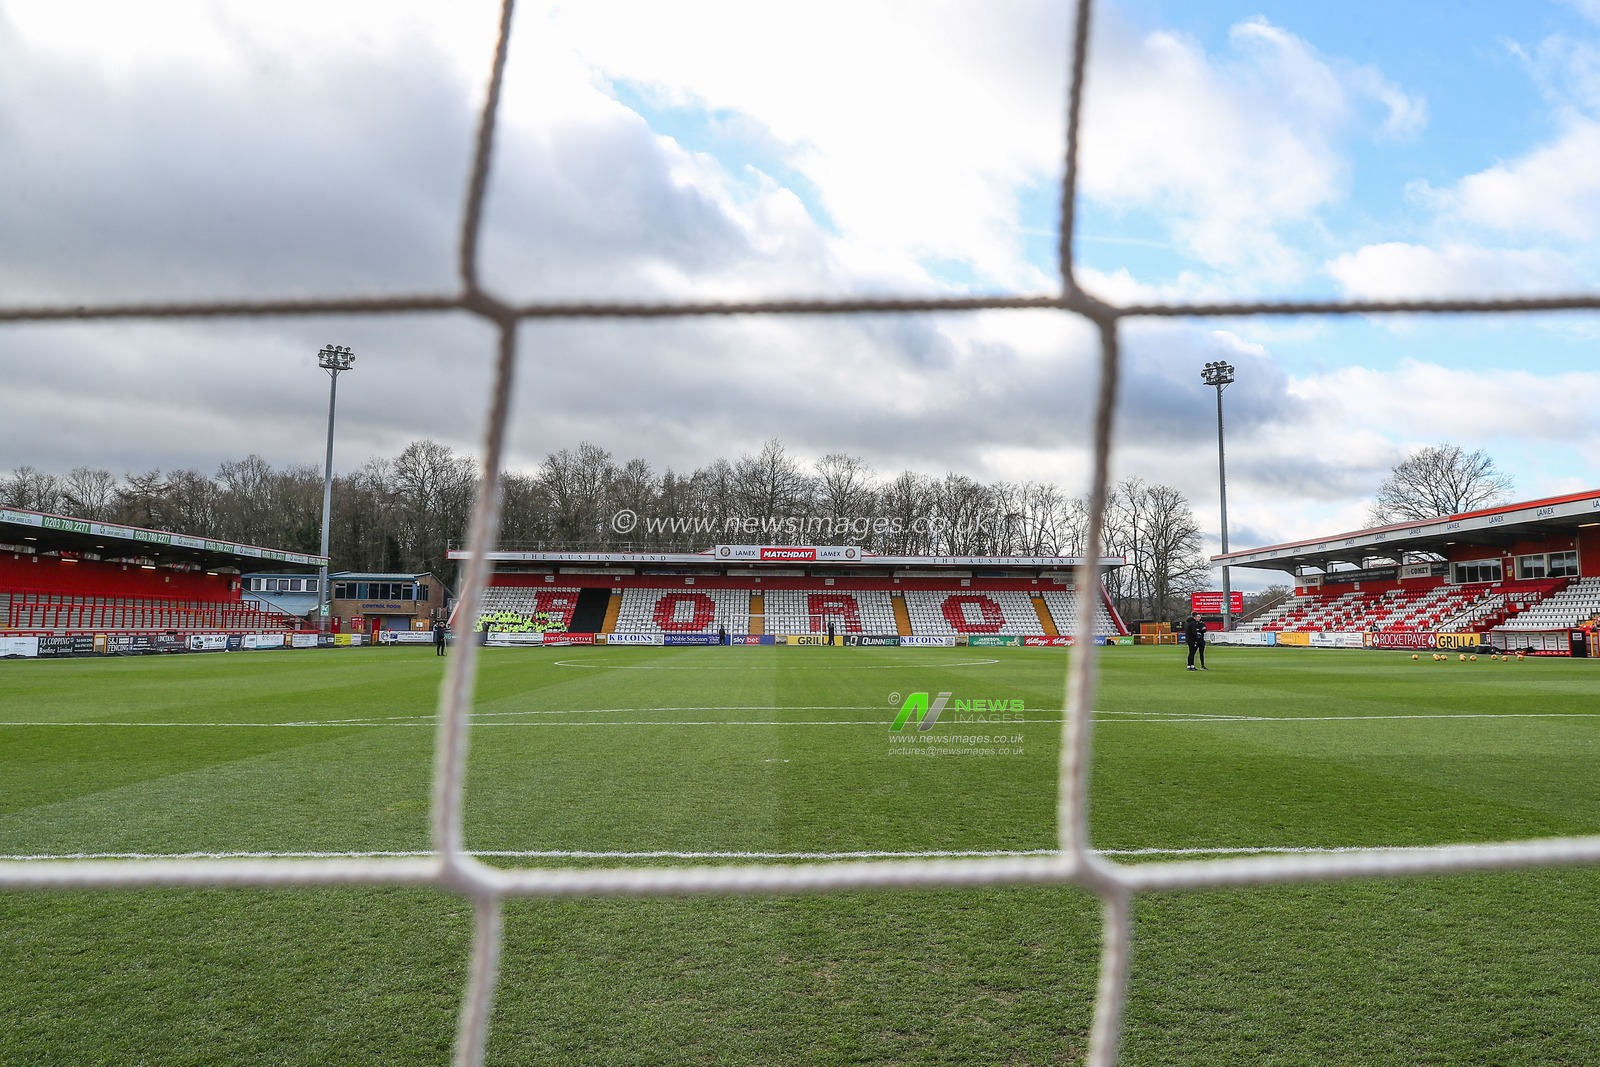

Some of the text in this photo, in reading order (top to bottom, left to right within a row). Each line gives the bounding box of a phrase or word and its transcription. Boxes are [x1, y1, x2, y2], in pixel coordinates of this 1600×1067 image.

[44, 517, 89, 532] 0203 780 2277
[862, 636, 899, 645] QUINNBET
[1380, 634, 1427, 646] ROCKETPAYE
[1439, 636, 1475, 648] GRILLA
